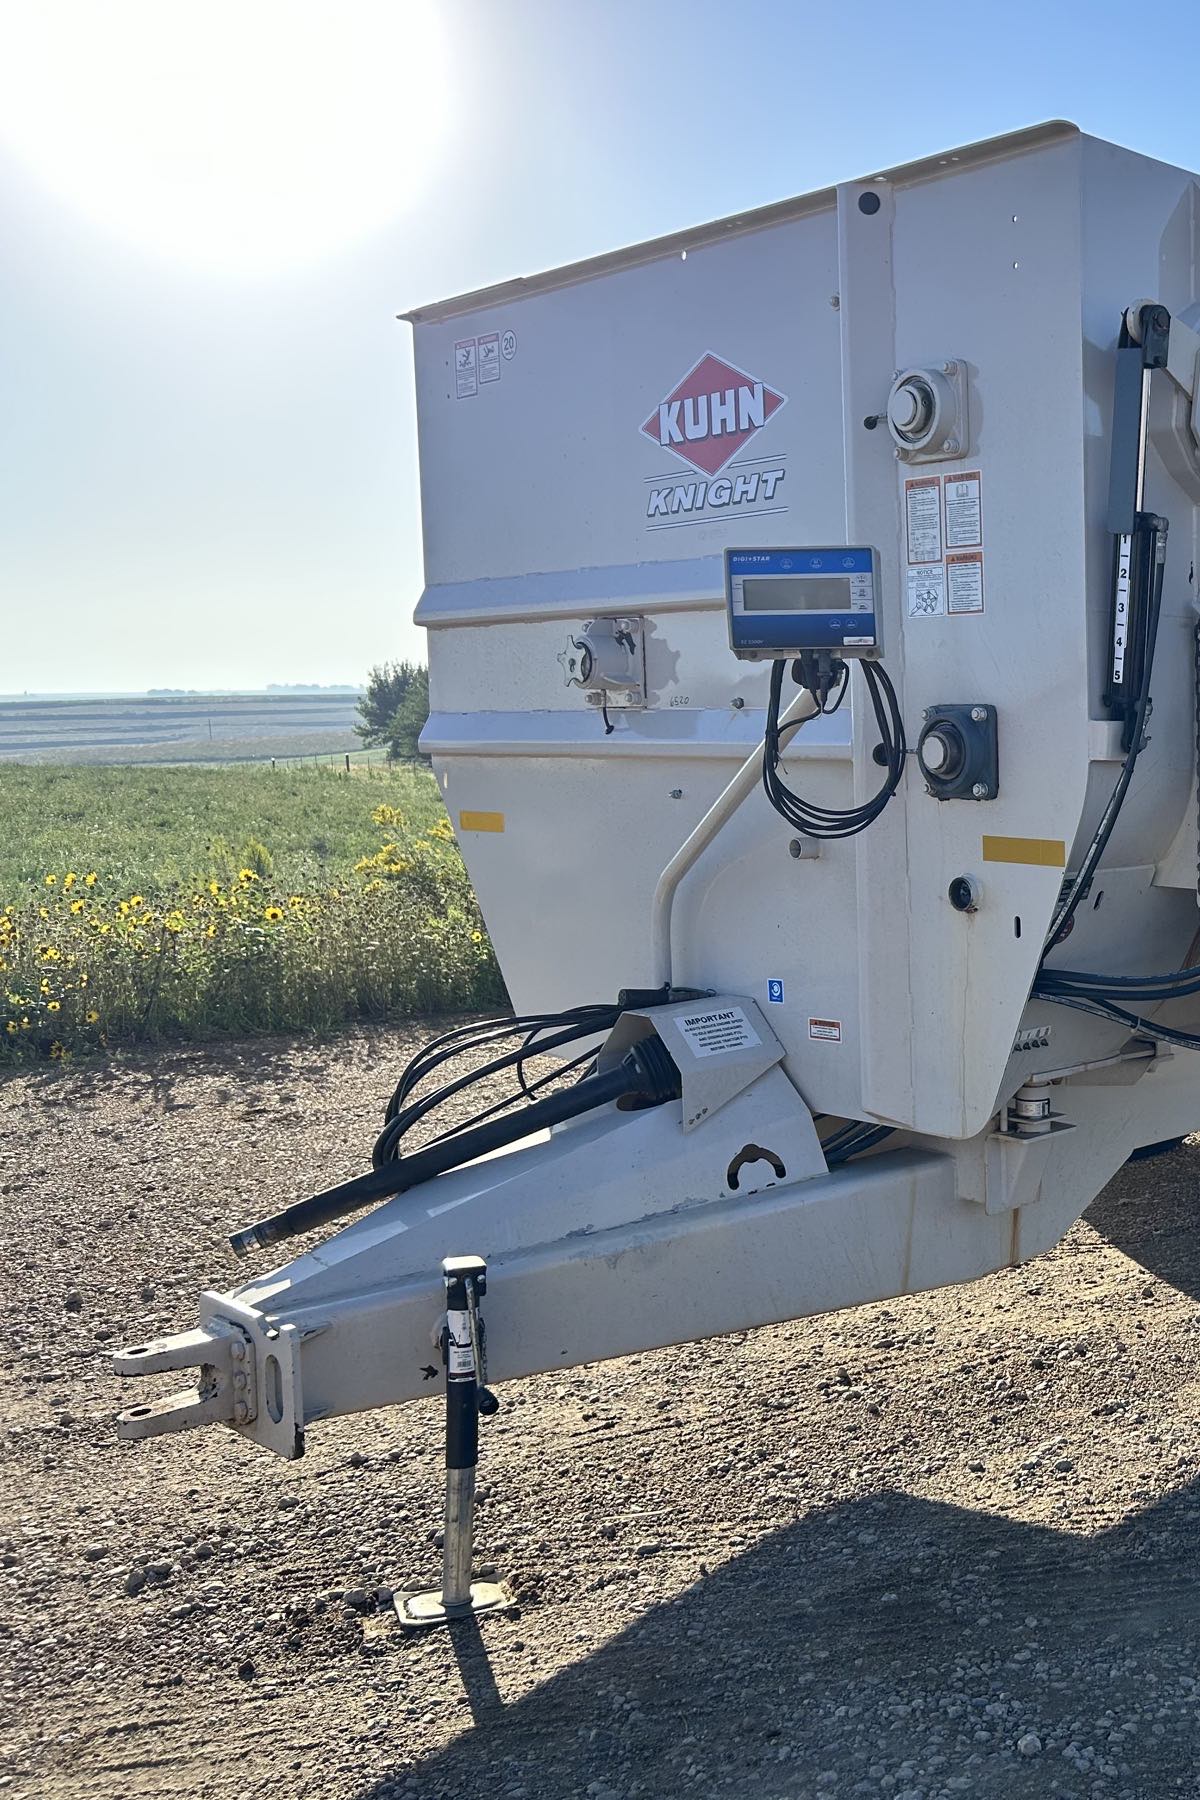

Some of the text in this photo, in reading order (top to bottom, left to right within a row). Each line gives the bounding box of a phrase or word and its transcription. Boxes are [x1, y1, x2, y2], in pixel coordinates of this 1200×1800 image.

[503, 335, 515, 352] 20
[659, 383, 765, 446] KUHN
[647, 469, 785, 517] KNIGHT
[1122, 535, 1127, 544] 1
[1120, 568, 1127, 578] 2
[1118, 603, 1125, 613] 3
[1116, 637, 1122, 646] 4
[1114, 670, 1120, 680] 5
[684, 1012, 735, 1026] IMPORTANT
